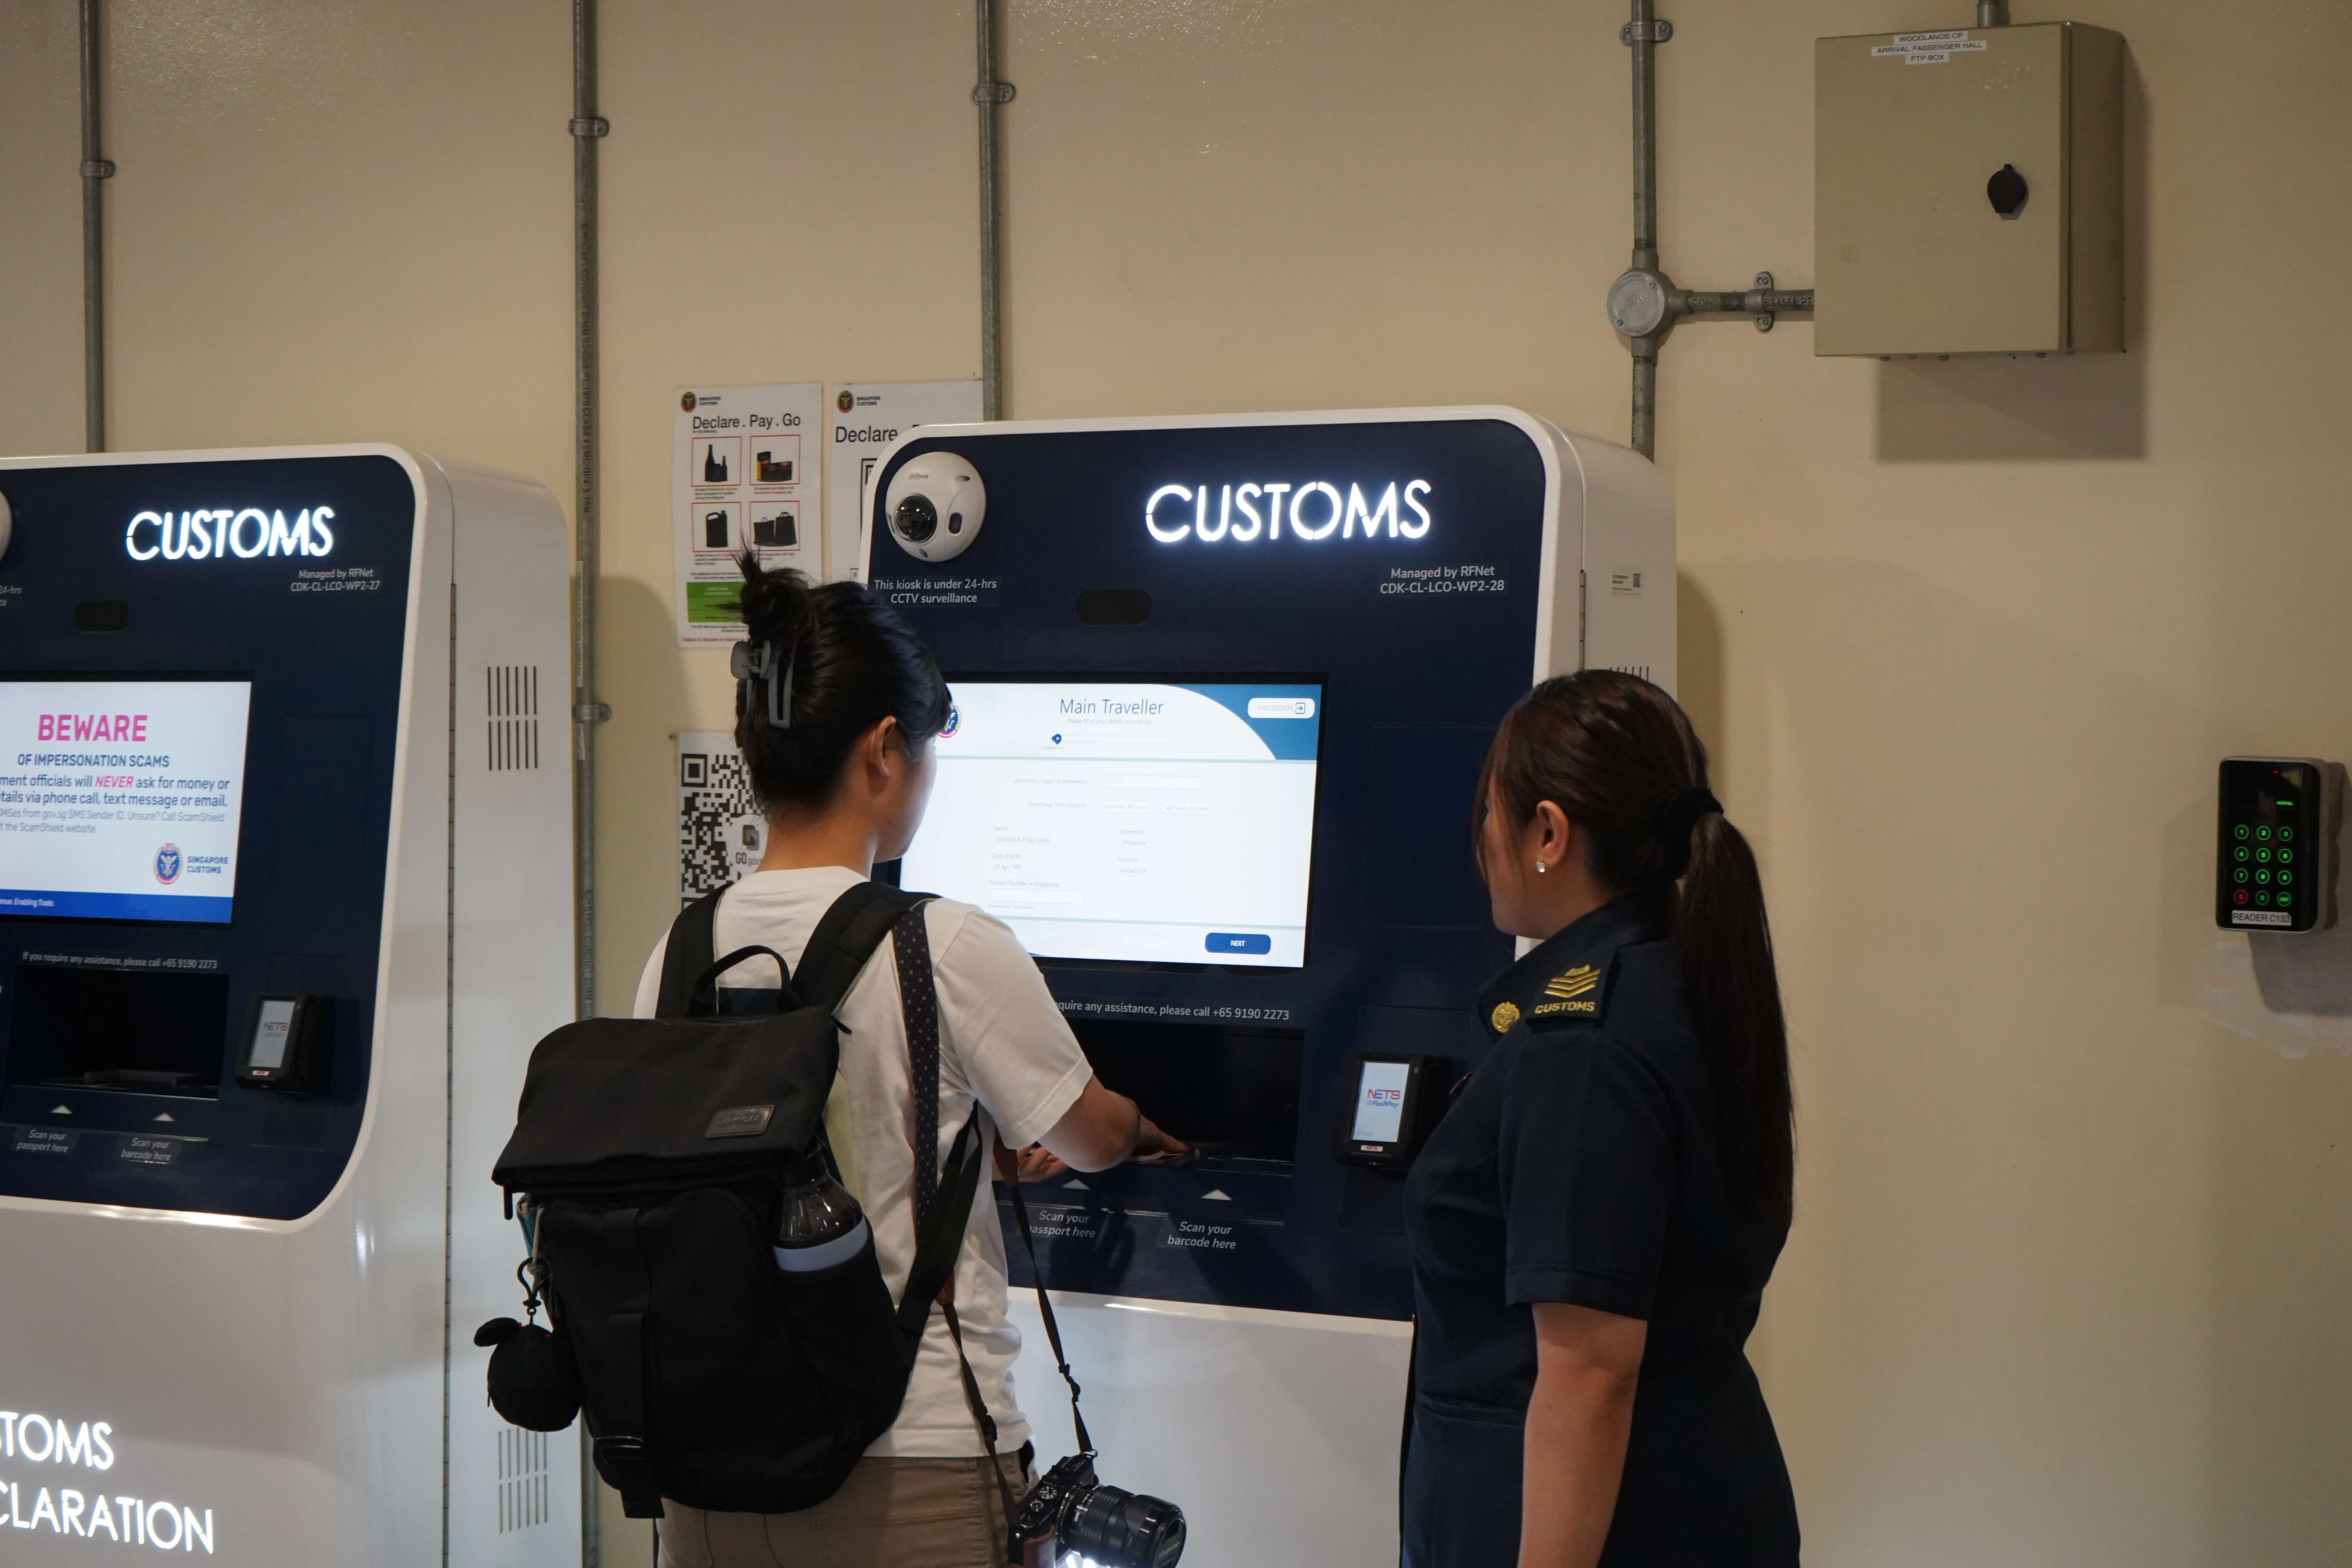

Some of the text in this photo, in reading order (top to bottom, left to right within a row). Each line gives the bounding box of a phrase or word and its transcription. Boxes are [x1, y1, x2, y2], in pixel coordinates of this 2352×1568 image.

[1899, 33, 1949, 42] WOODLANDS
[1913, 43, 1960, 51] PASSENGER
[583, 408, 591, 436] CLASS
[692, 413, 800, 430] Declare Pay Go
[835, 426, 898, 443] Declare
[1145, 479, 1432, 543] CUSTOMS
[125, 506, 335, 561] CUSTOMS
[298, 568, 374, 580] Managed by RFNet
[1391, 565, 1495, 580] Managed by RFNet
[290, 581, 381, 592] CDK-CL-LCO-WP2-27
[874, 579, 997, 590] This kiosk is under 24-hrs
[1380, 580, 1505, 594] CDK-CL-LCO-WP2-28
[891, 593, 978, 604] CCTV surveillance
[1060, 698, 1164, 715] Main Traveller
[38, 714, 148, 742] BEWARE
[17, 753, 170, 768] OF IMPERSONATION SCAMS
[0, 774, 230, 792] ment officials will NEVER ask for money or
[0, 790, 228, 809] tails via phone call, text message or email.
[22, 808, 40, 818] from
[42, 810, 67, 821] gov.sg
[68, 809, 85, 819] SMS
[87, 809, 114, 820] Sender
[127, 811, 160, 821] Unsure?
[161, 811, 176, 821] Call
[178, 812, 225, 822] ScamShield
[5, 823, 18, 831] the
[20, 822, 64, 832] ScamShield
[65, 823, 98, 833] website.
[736, 852, 747, 864] GO
[187, 865, 221, 874] CUSTOMS
[2233, 913, 2290, 923] READER C133
[22, 951, 29, 960] If
[29, 953, 41, 962] you
[44, 953, 68, 964] require
[70, 956, 82, 965] any
[123, 957, 147, 967] please
[148, 958, 160, 967] call
[162, 959, 176, 968] +65
[178, 959, 196, 968] 9190
[198, 960, 218, 969] 2273
[1085, 1002, 1103, 1013] any
[1105, 1002, 1157, 1015] assistance,
[1159, 1005, 1191, 1016] please
[1193, 1006, 1210, 1016] call
[1213, 1007, 1232, 1018] +65
[1234, 1008, 1261, 1019] 9190
[1263, 1009, 1290, 1020] 2273
[1534, 1001, 1597, 1014] CUSTOMS
[263, 1022, 289, 1031] NETS
[1367, 1089, 1401, 1100] NETS
[1372, 1100, 1399, 1109] FlashPay
[28, 1129, 67, 1141] Scan your
[16, 1142, 69, 1153] passport here
[131, 1137, 171, 1150] Scan your
[121, 1149, 172, 1161] barcode here
[1039, 1210, 1091, 1224] Scan your
[1072, 1226, 1096, 1238] here
[1179, 1221, 1233, 1236] Scan your
[1167, 1234, 1236, 1249] barcode here
[0, 1411, 114, 1470] TOMS
